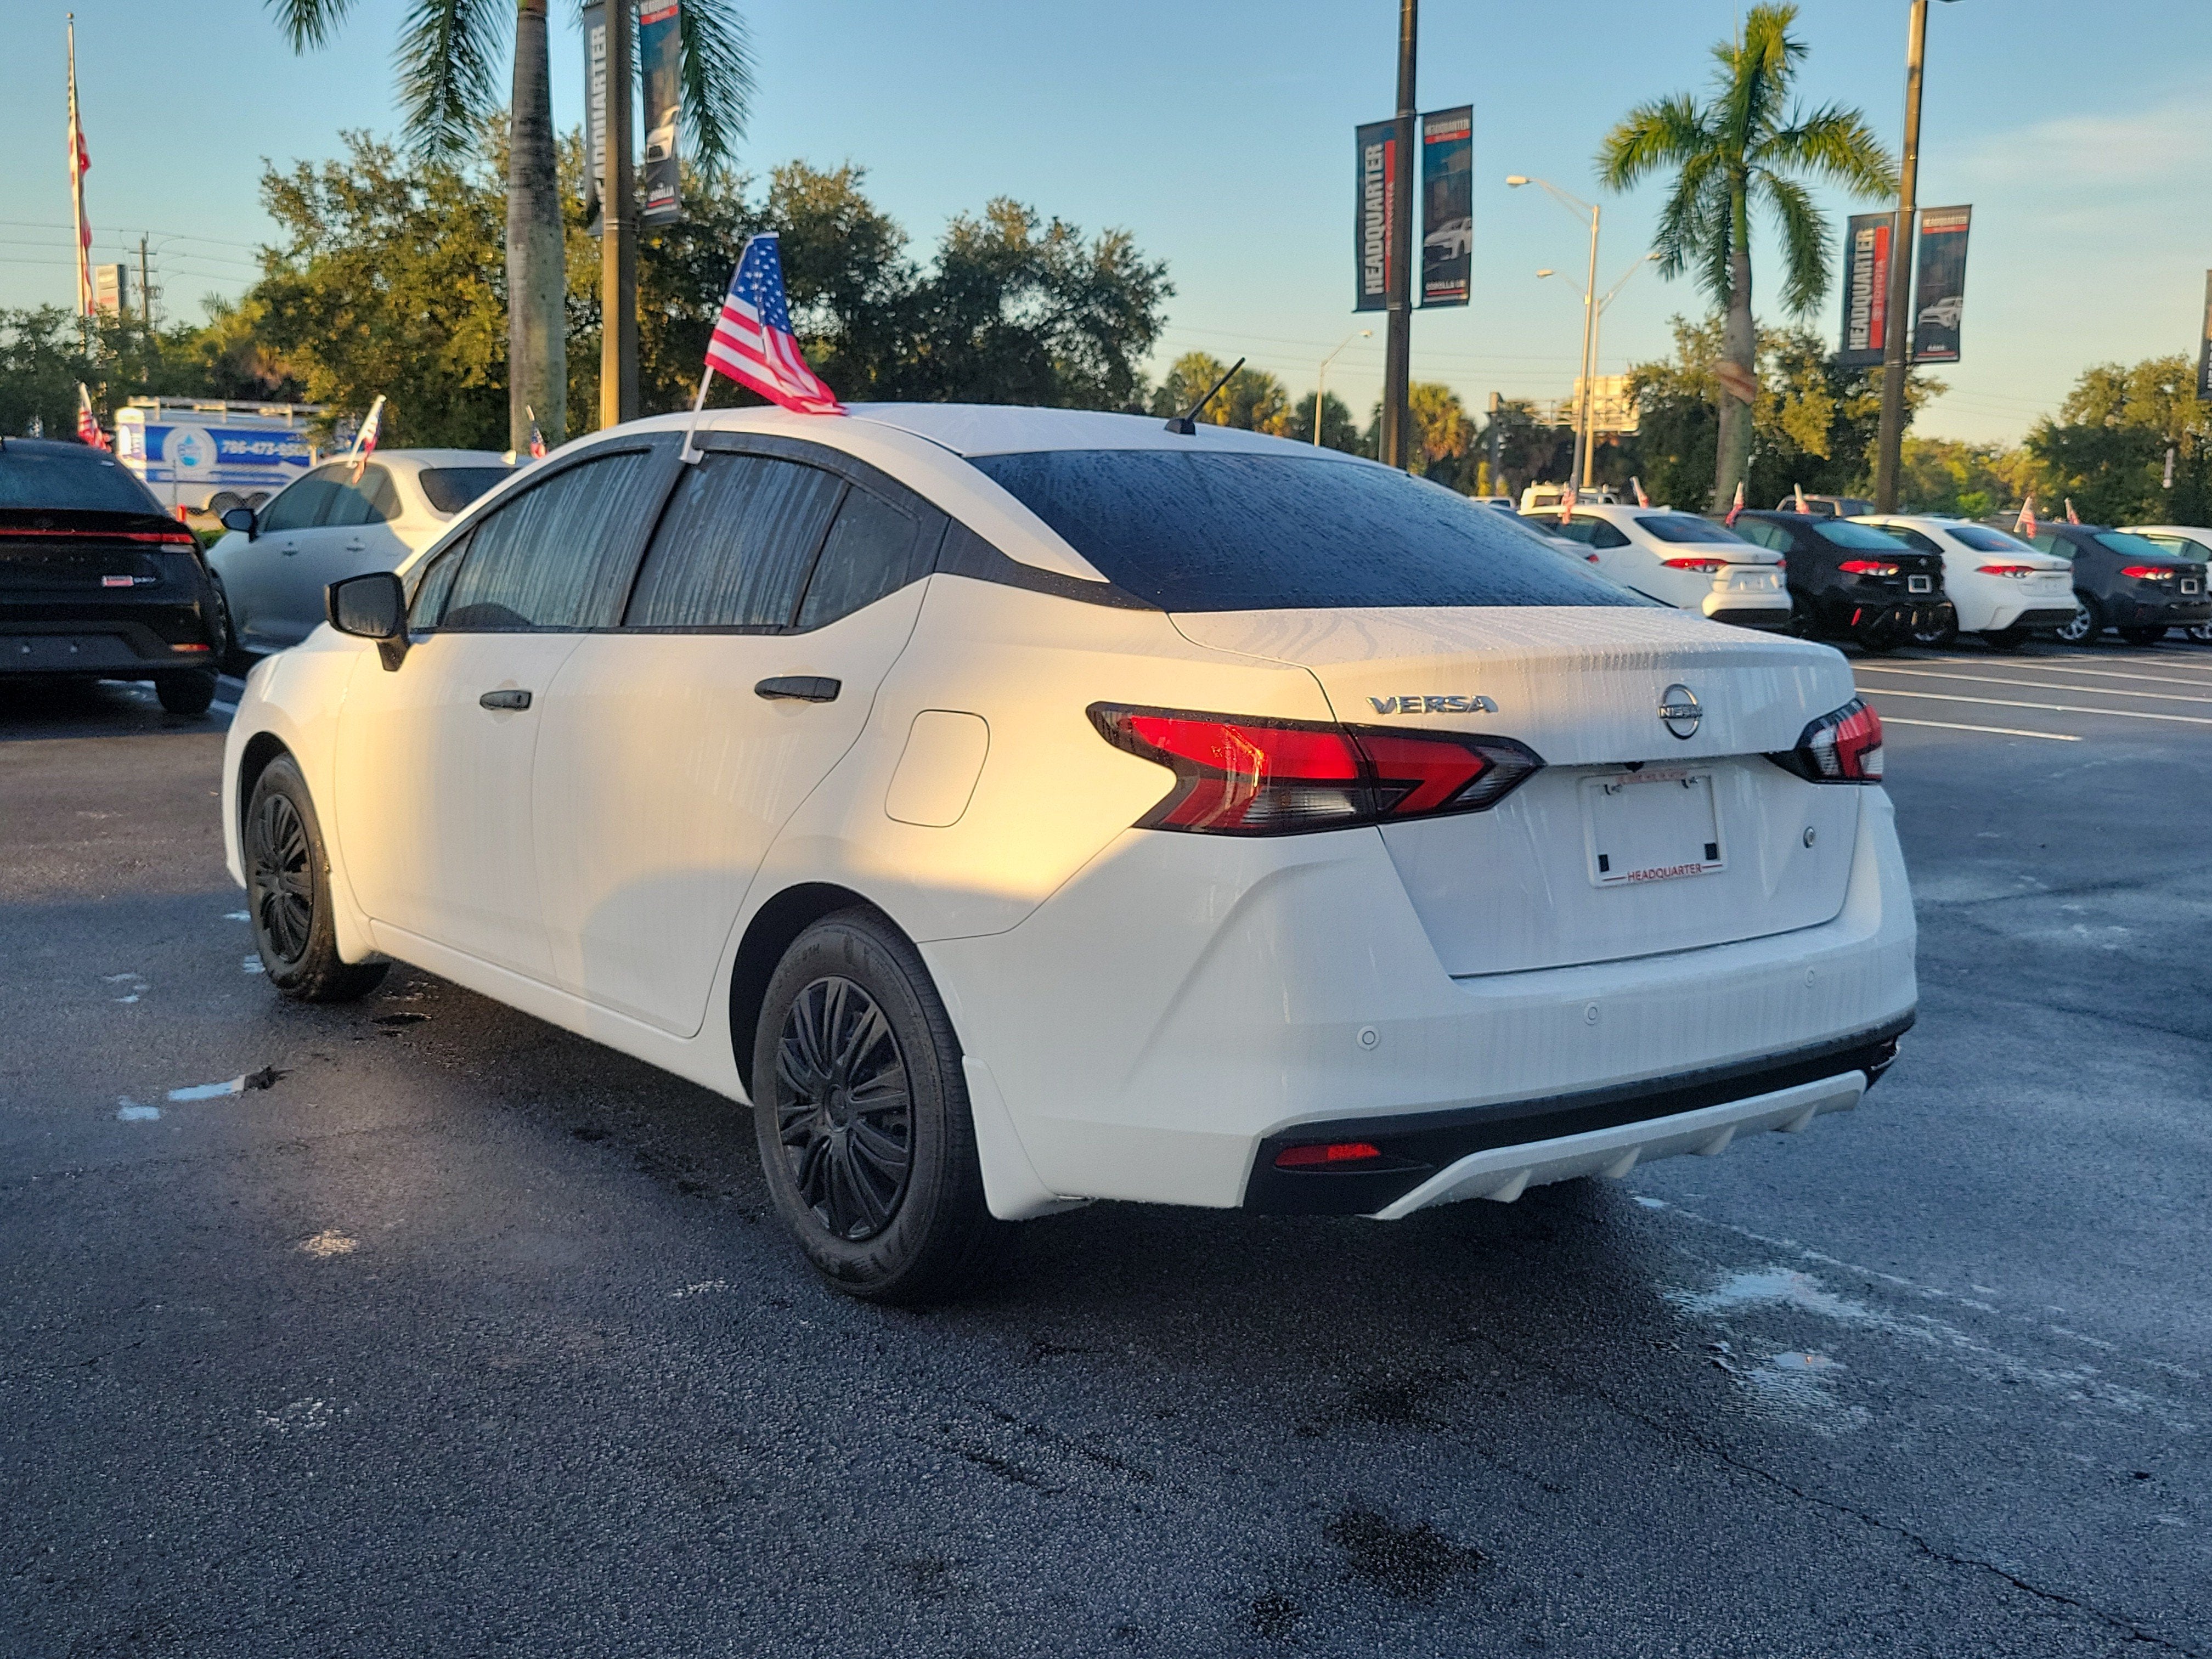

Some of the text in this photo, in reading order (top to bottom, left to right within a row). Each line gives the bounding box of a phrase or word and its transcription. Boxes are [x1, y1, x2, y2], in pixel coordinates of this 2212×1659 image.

[1364, 144, 1385, 295] HEADQUARTER
[1849, 227, 1875, 350] HEADQUARTER
[1872, 258, 1887, 304] TOYOTA
[1366, 695, 1499, 714] VERSA
[1658, 706, 1702, 718] NISSAN
[1627, 863, 1702, 882] HEADQUARTER
